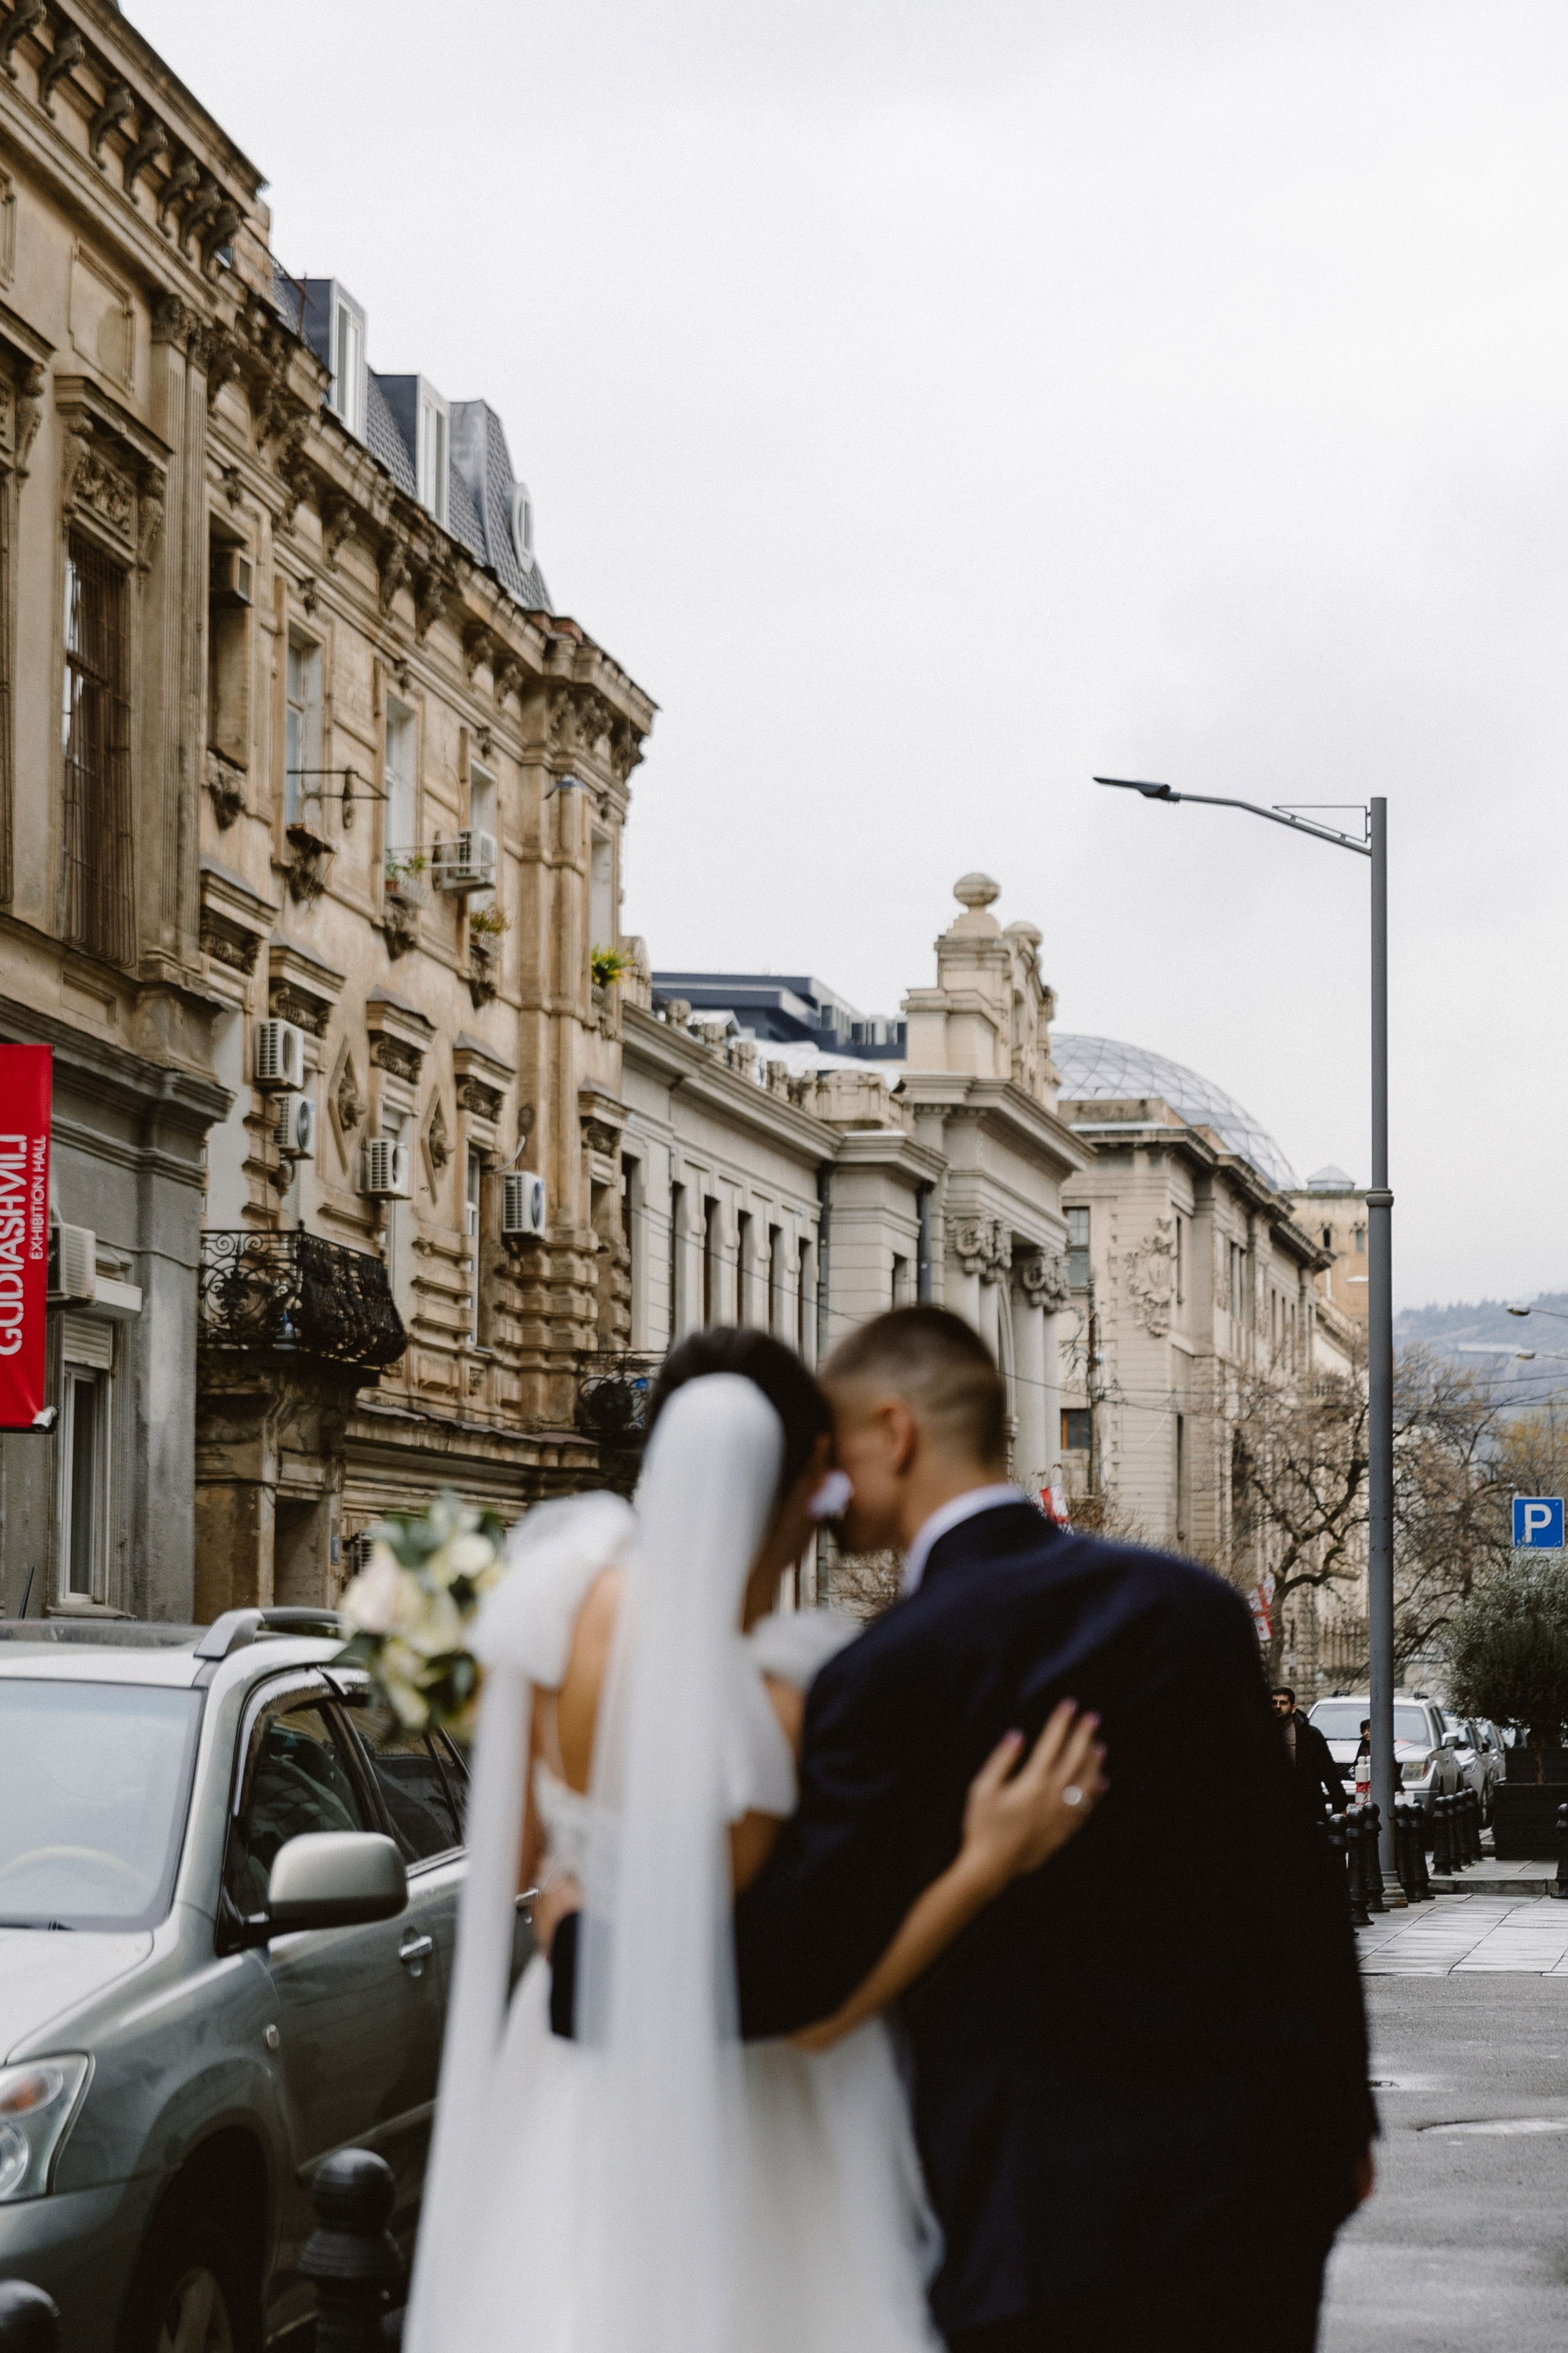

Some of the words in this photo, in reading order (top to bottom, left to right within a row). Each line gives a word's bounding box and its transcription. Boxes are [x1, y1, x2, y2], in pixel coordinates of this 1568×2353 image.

[32, 1135, 47, 1172] HALL
[0, 1135, 27, 1356] GUDIASHVILI
[29, 1175, 45, 1260] EXHIBITION
[1524, 1503, 1552, 1543] P
